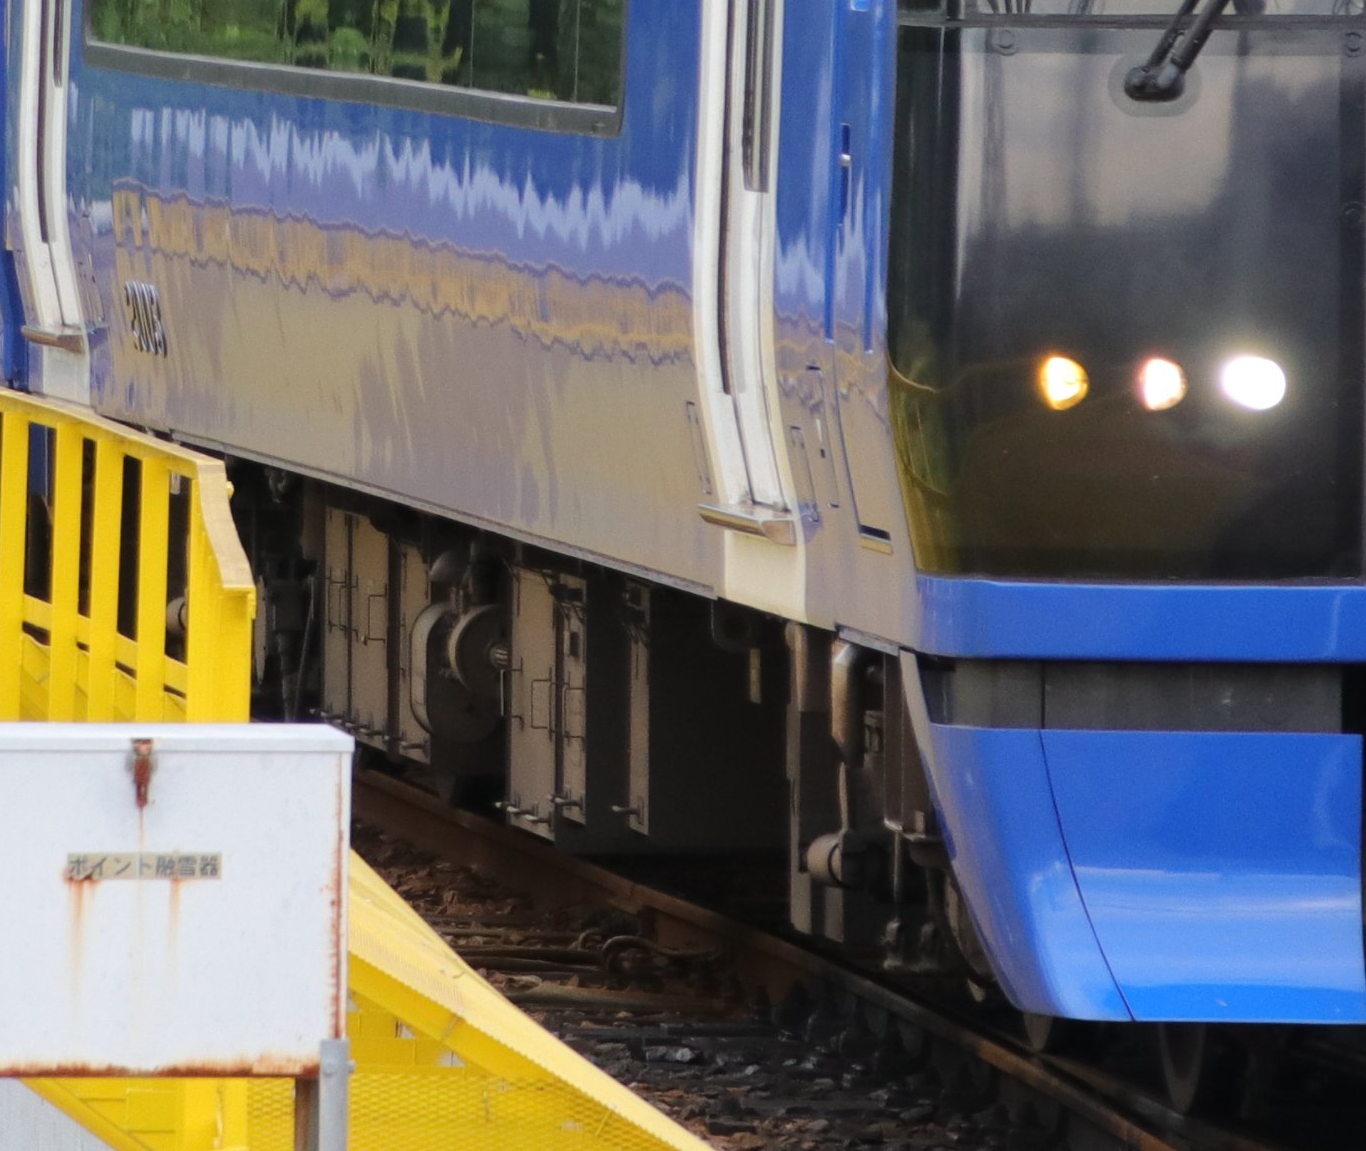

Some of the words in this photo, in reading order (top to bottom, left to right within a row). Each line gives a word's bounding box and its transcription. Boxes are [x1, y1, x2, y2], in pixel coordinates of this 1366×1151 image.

[70, 855, 219, 877] ポイント融雪器
